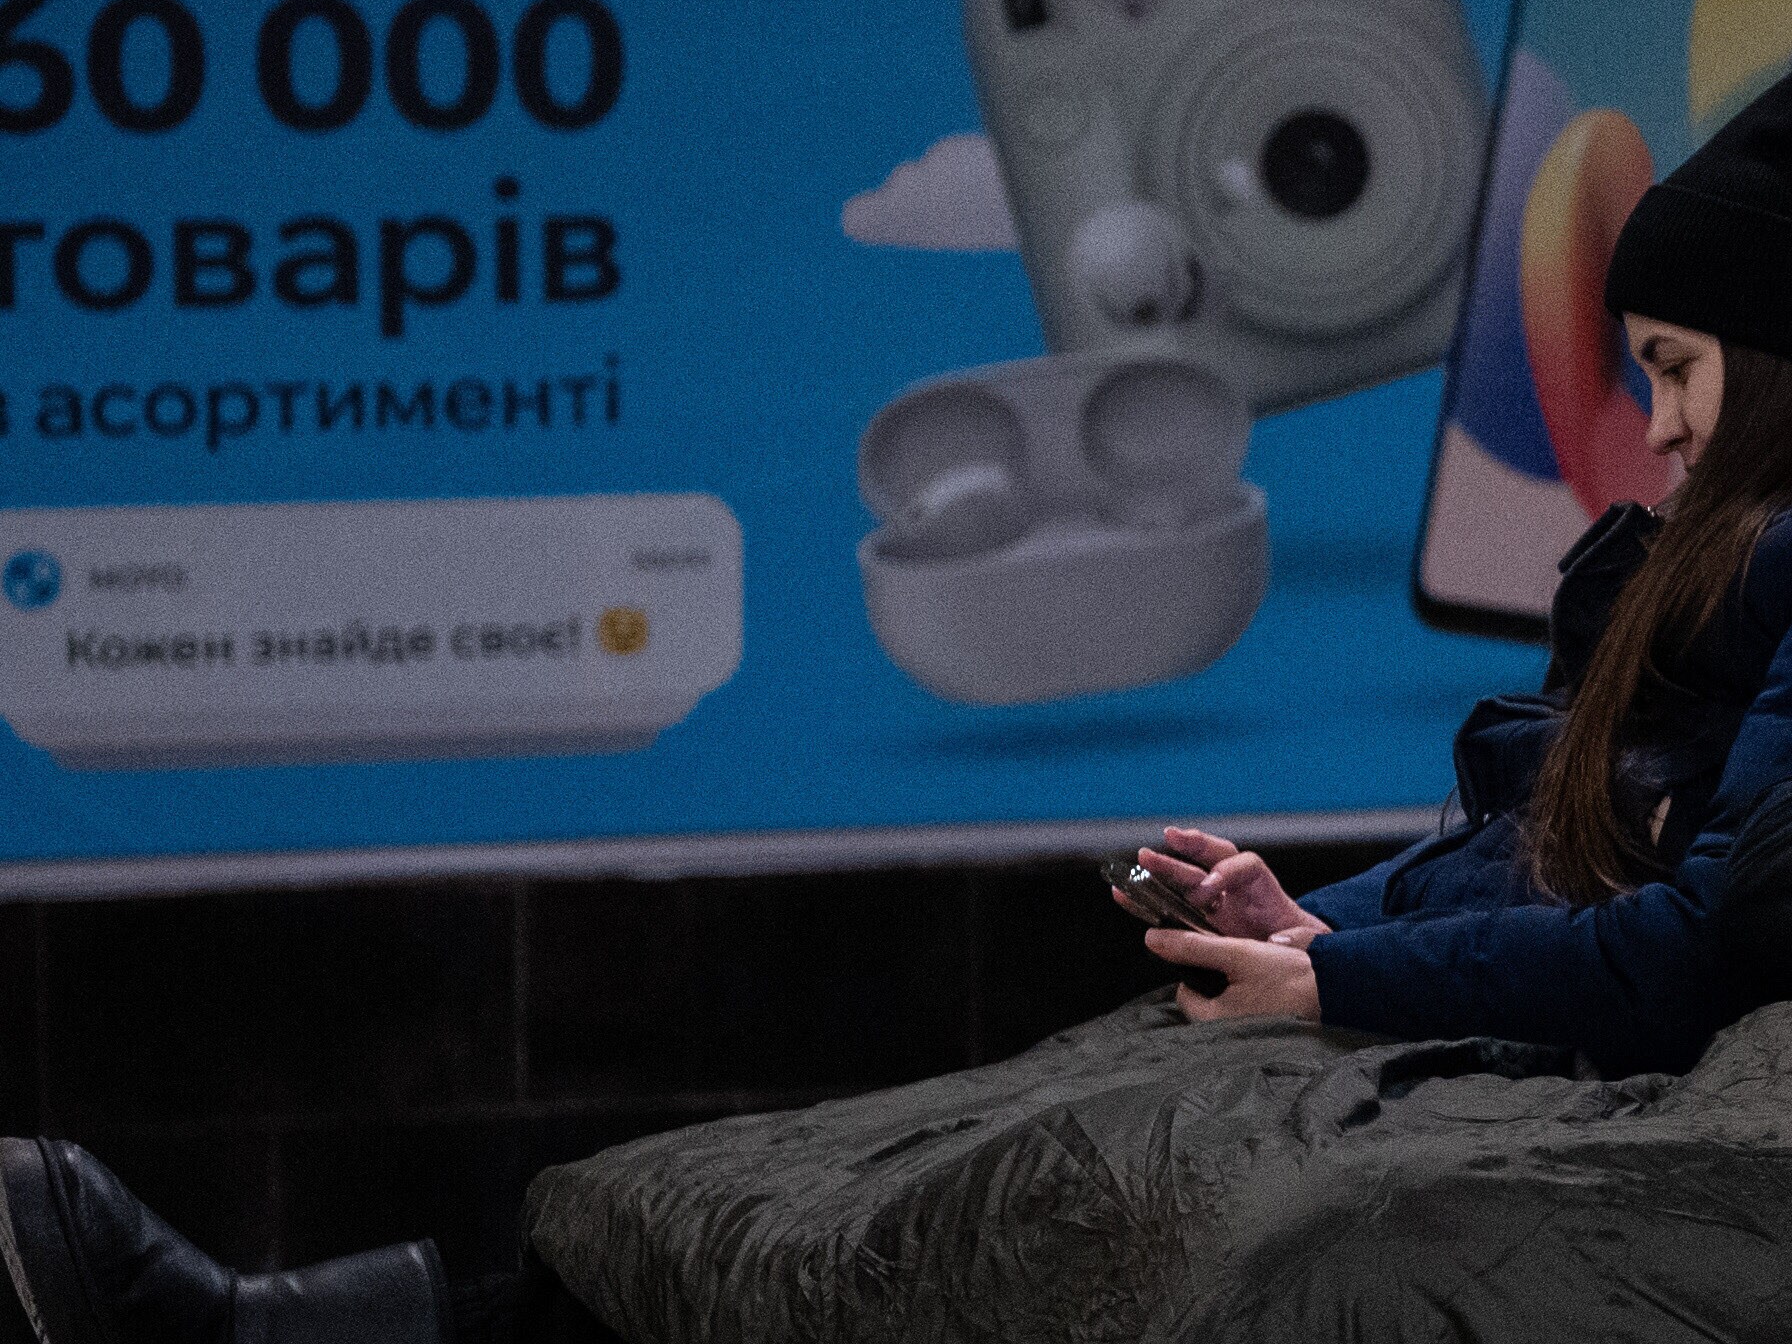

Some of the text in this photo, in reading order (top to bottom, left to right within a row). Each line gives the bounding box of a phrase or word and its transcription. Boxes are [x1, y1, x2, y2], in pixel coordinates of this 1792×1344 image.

[36, 355, 621, 452] асортименті
[66, 627, 234, 669] Кожен
[251, 620, 435, 665] знайде
